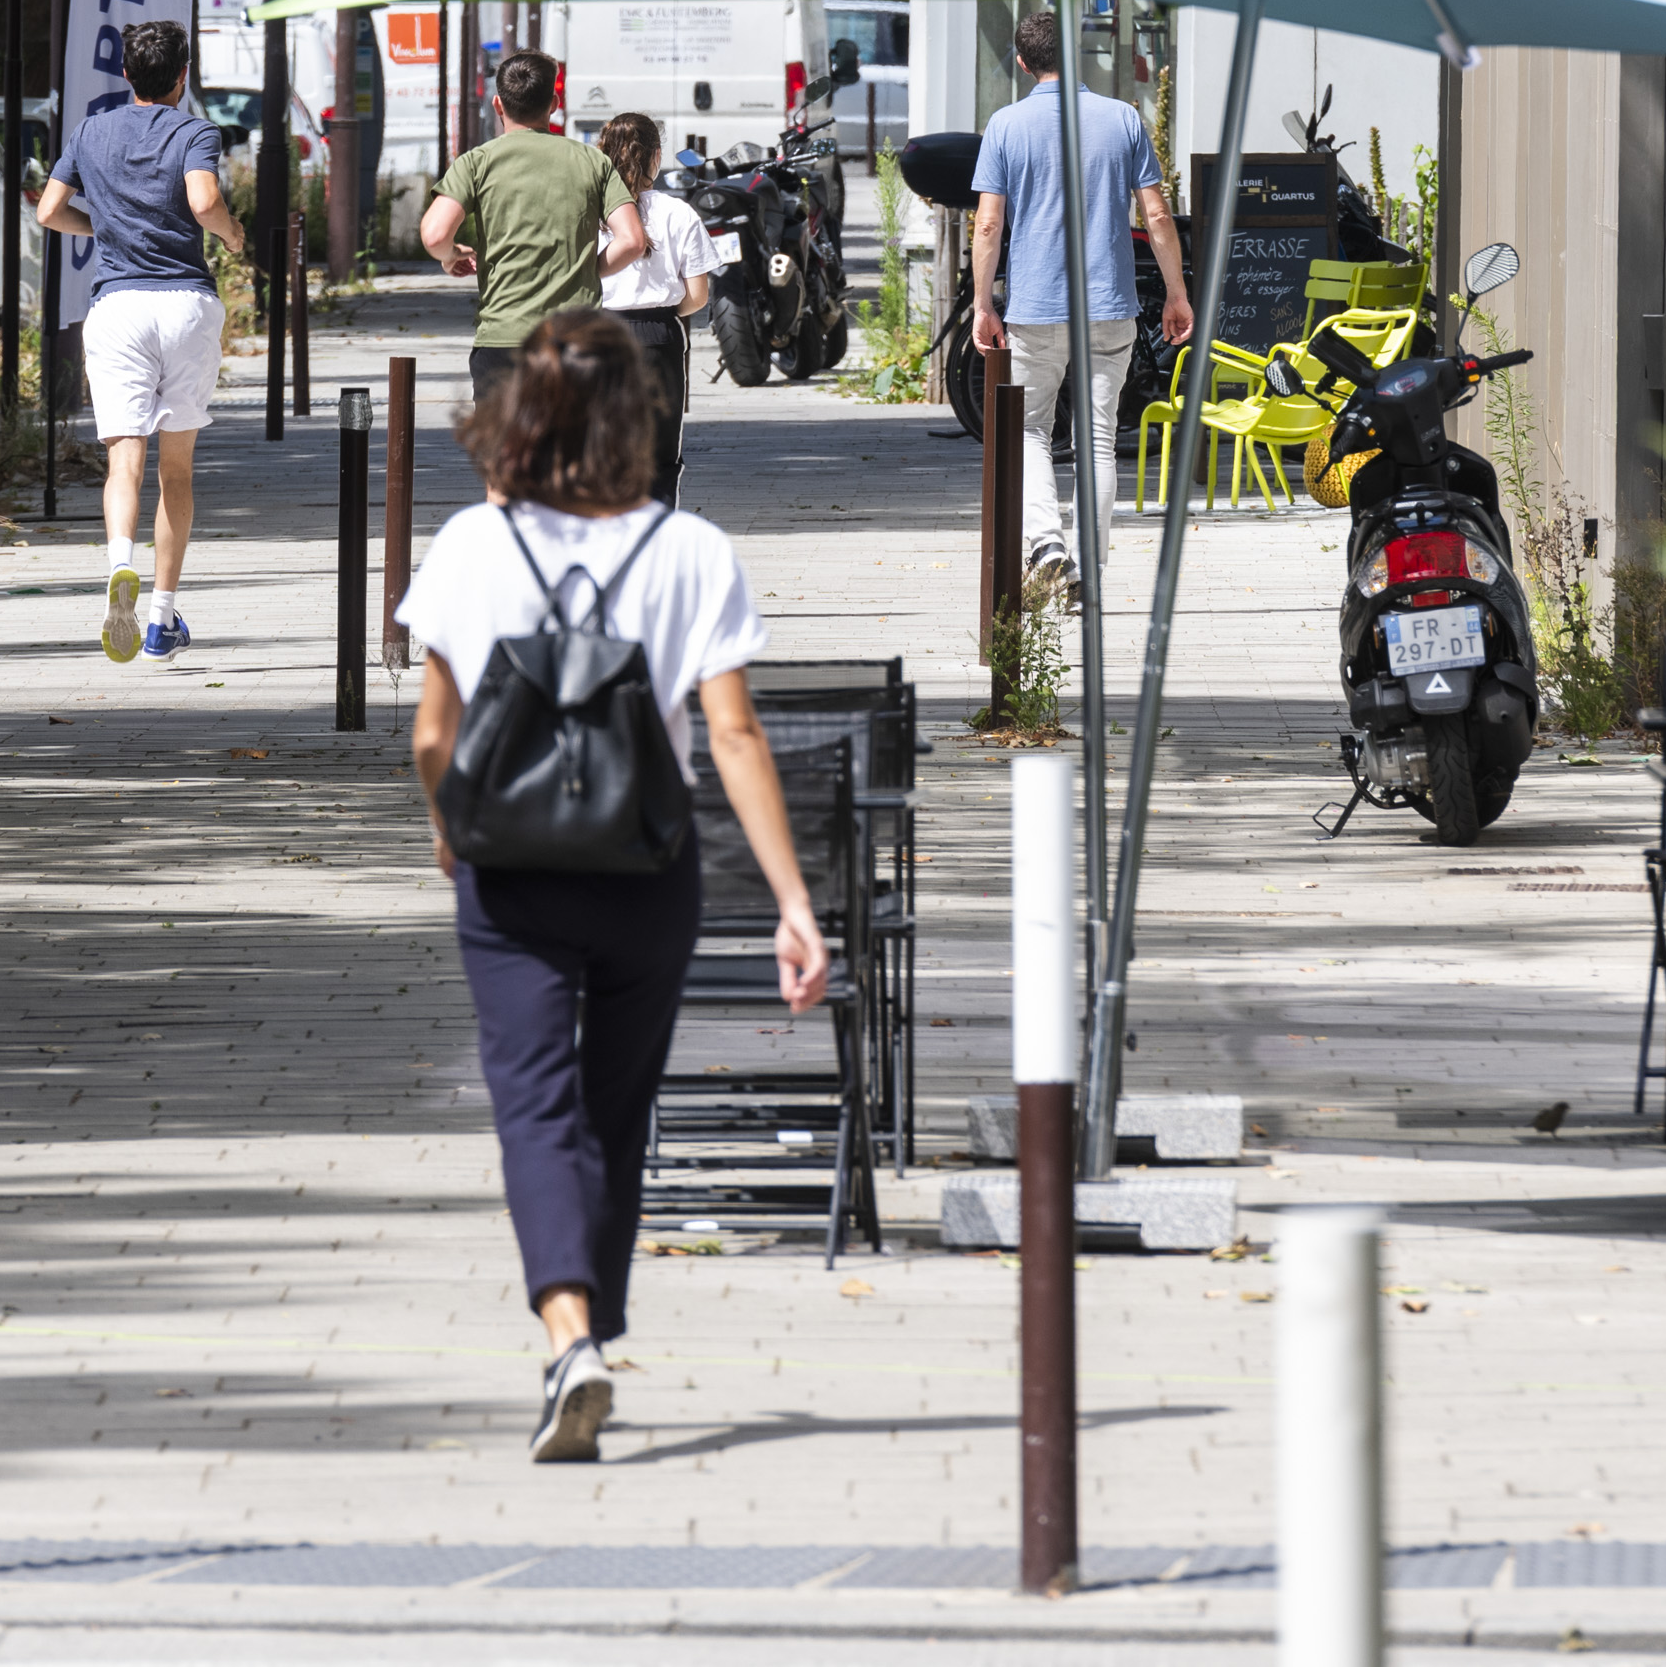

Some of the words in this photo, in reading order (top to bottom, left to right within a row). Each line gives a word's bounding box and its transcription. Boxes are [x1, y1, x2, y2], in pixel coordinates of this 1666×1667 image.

[1235, 179, 1263, 187] LERIE
[1271, 192, 1315, 201] QUARTUS
[1227, 232, 1310, 259] TERRASSE
[1270, 301, 1294, 321] SANS
[1395, 636, 1476, 663] 297-DT
